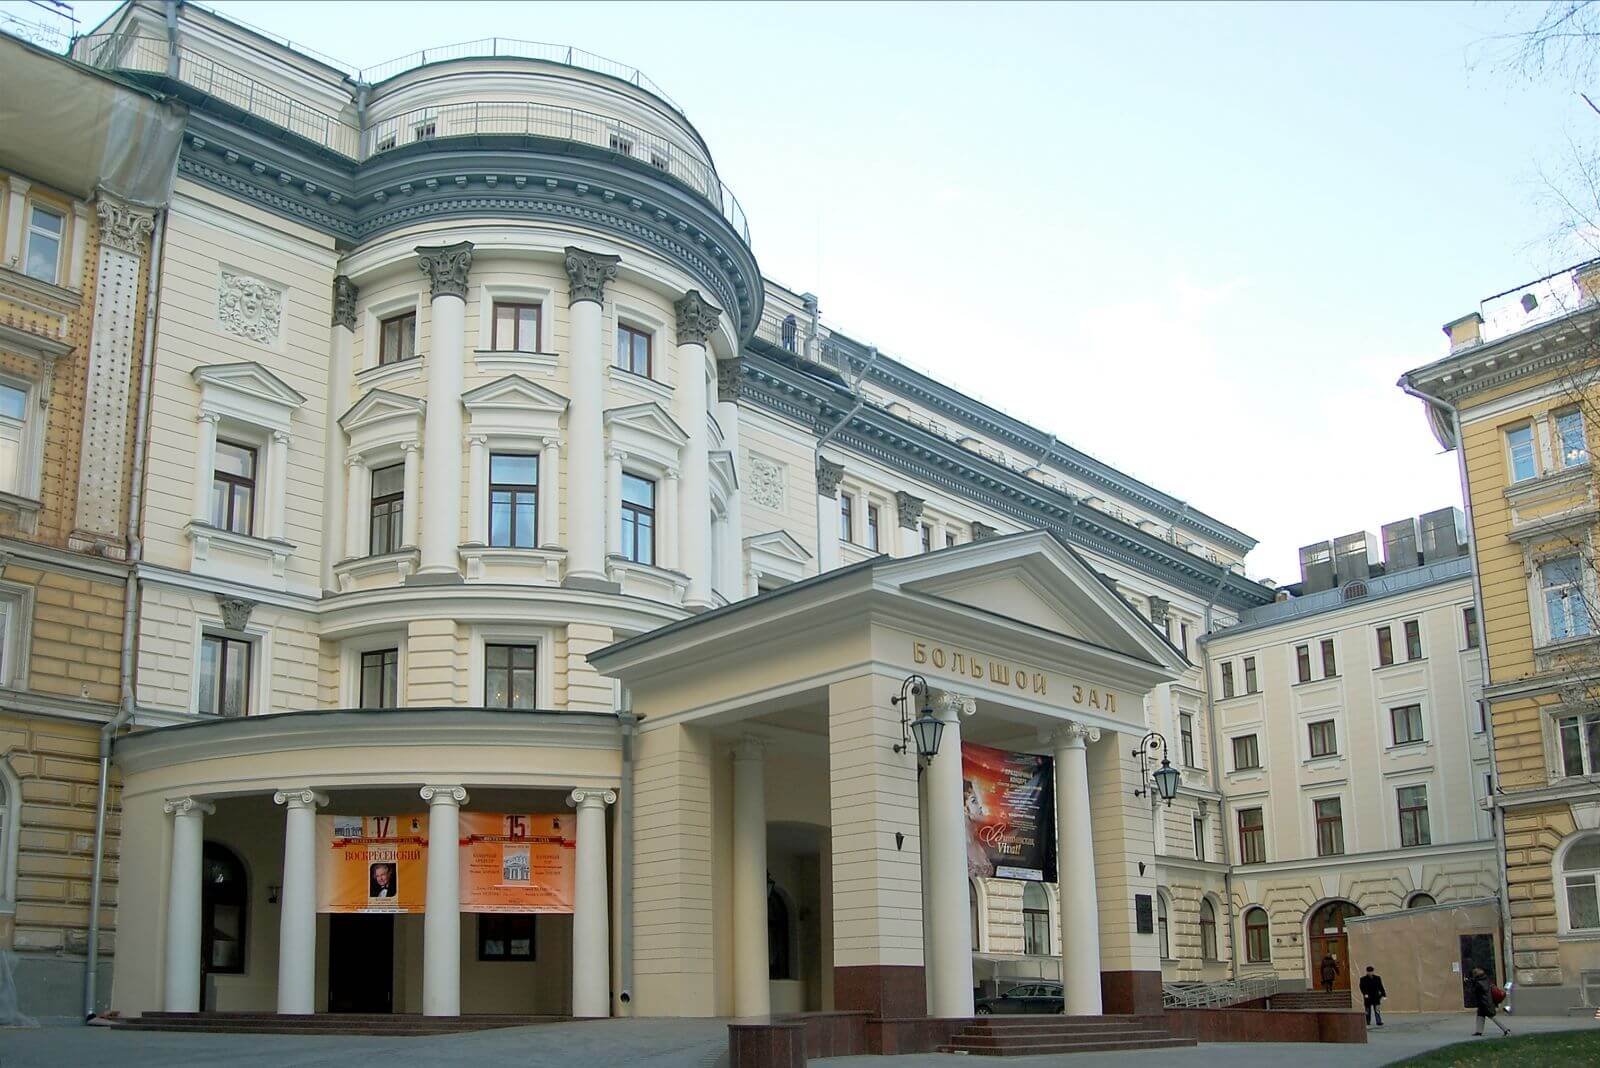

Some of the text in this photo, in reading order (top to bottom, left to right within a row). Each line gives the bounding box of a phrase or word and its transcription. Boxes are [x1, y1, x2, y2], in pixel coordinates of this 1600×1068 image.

[913, 640, 1117, 713] БОЛЬШОЙ ЗАЛ
[373, 816, 390, 838] 17
[506, 815, 526, 841] 15
[345, 850, 420, 861] ВОСКРЕСЕНСКИЙ
